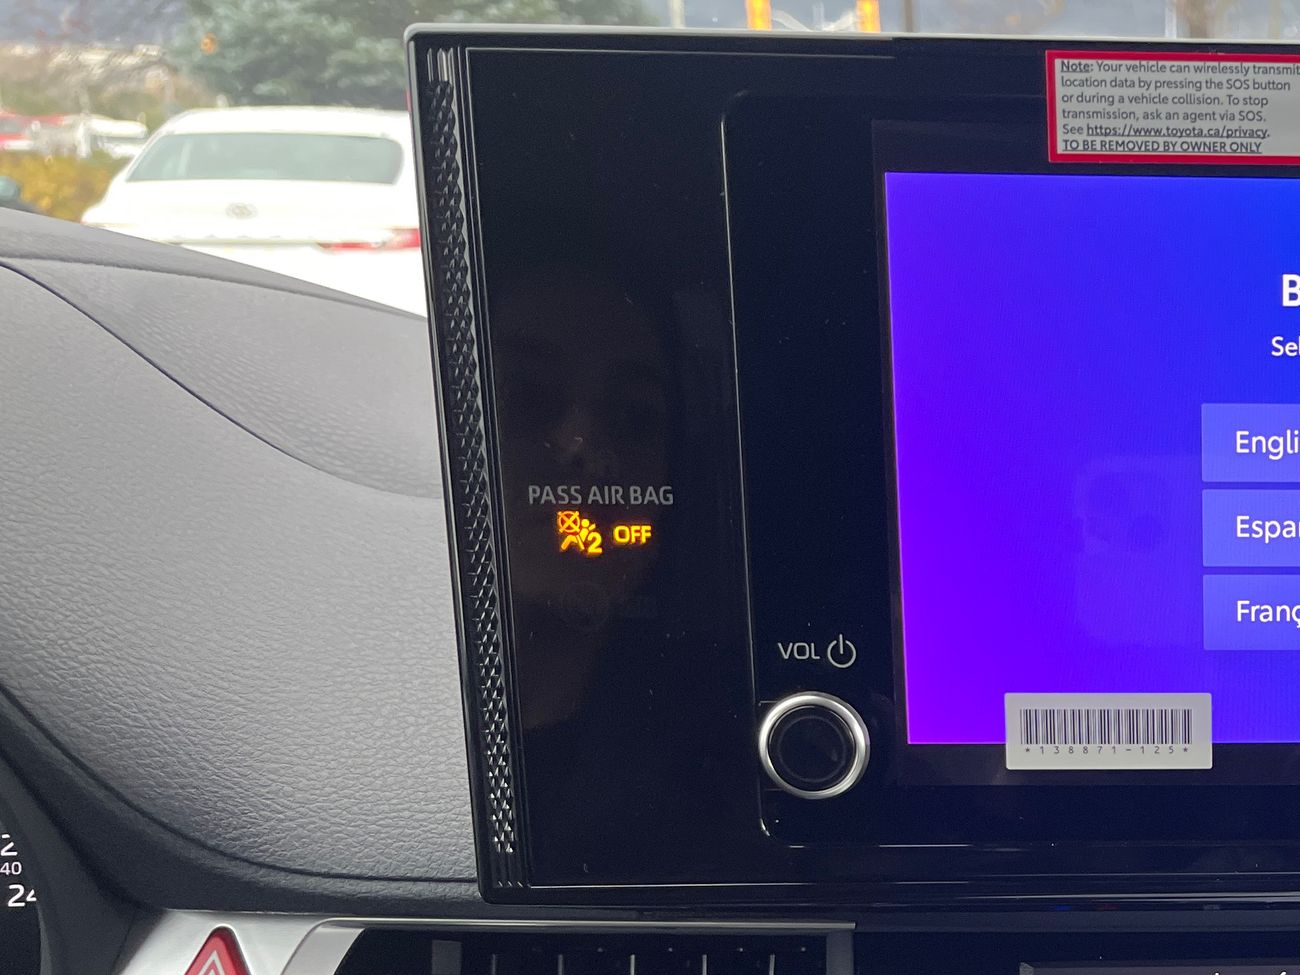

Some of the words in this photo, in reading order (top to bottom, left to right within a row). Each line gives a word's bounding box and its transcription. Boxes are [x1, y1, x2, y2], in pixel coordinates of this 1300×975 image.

[1060, 60, 1094, 76] Note:
[1096, 61, 1123, 72] Your
[1125, 61, 1167, 73] vehicle
[1169, 64, 1190, 74] can
[1193, 61, 1250, 77] wirelessly
[1061, 75, 1107, 88] location
[1109, 76, 1135, 88] data
[1138, 76, 1152, 91] by
[1154, 77, 1202, 92] pressing
[1205, 78, 1224, 90] the
[1226, 78, 1250, 90] SOS
[1252, 78, 1291, 90] button
[1061, 94, 1074, 103] or
[1076, 91, 1115, 107] during
[1118, 95, 1125, 104] a
[1127, 92, 1169, 104] vehicle
[1171, 93, 1223, 105] collision.
[1226, 94, 1240, 105] To
[1242, 95, 1269, 108] stop
[1061, 107, 1139, 121] transmission,
[1142, 108, 1162, 120] ask
[1165, 112, 1180, 121] an
[1182, 110, 1217, 124] agent
[1219, 109, 1236, 121] via
[1238, 110, 1266, 121] SOS.
[1062, 123, 1084, 135] See
[1086, 123, 1270, 140] https://www.toyota.ca/privacy.
[1061, 139, 1080, 152] TO
[1082, 139, 1098, 152] BE
[1099, 139, 1161, 153] REMOVED
[1163, 140, 1178, 153] BY
[1179, 140, 1227, 154] OWNER
[1229, 141, 1262, 154] ONLY
[528, 486, 581, 505] PASS
[588, 486, 625, 505] AIR
[630, 485, 674, 505] BAG
[613, 525, 652, 545] OFF
[778, 642, 820, 660] VOL
